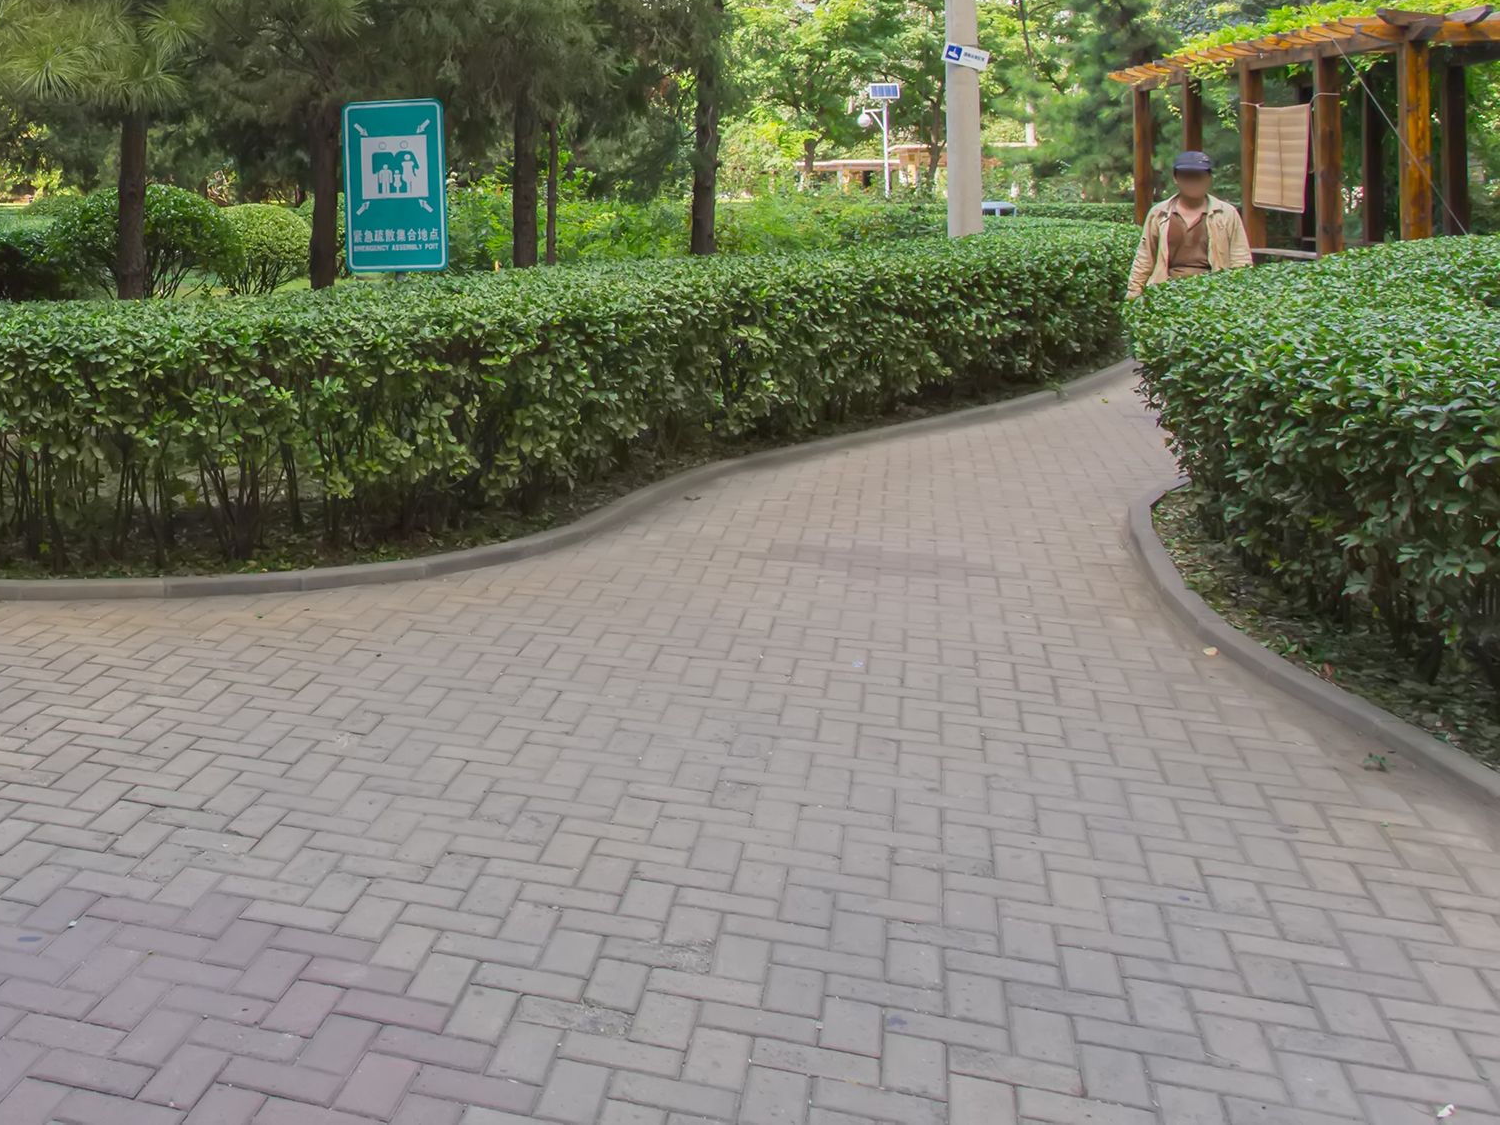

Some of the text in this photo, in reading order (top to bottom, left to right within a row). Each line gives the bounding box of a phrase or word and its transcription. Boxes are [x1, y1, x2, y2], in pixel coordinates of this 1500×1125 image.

[354, 228, 439, 243] 紧急疏散集合地点
